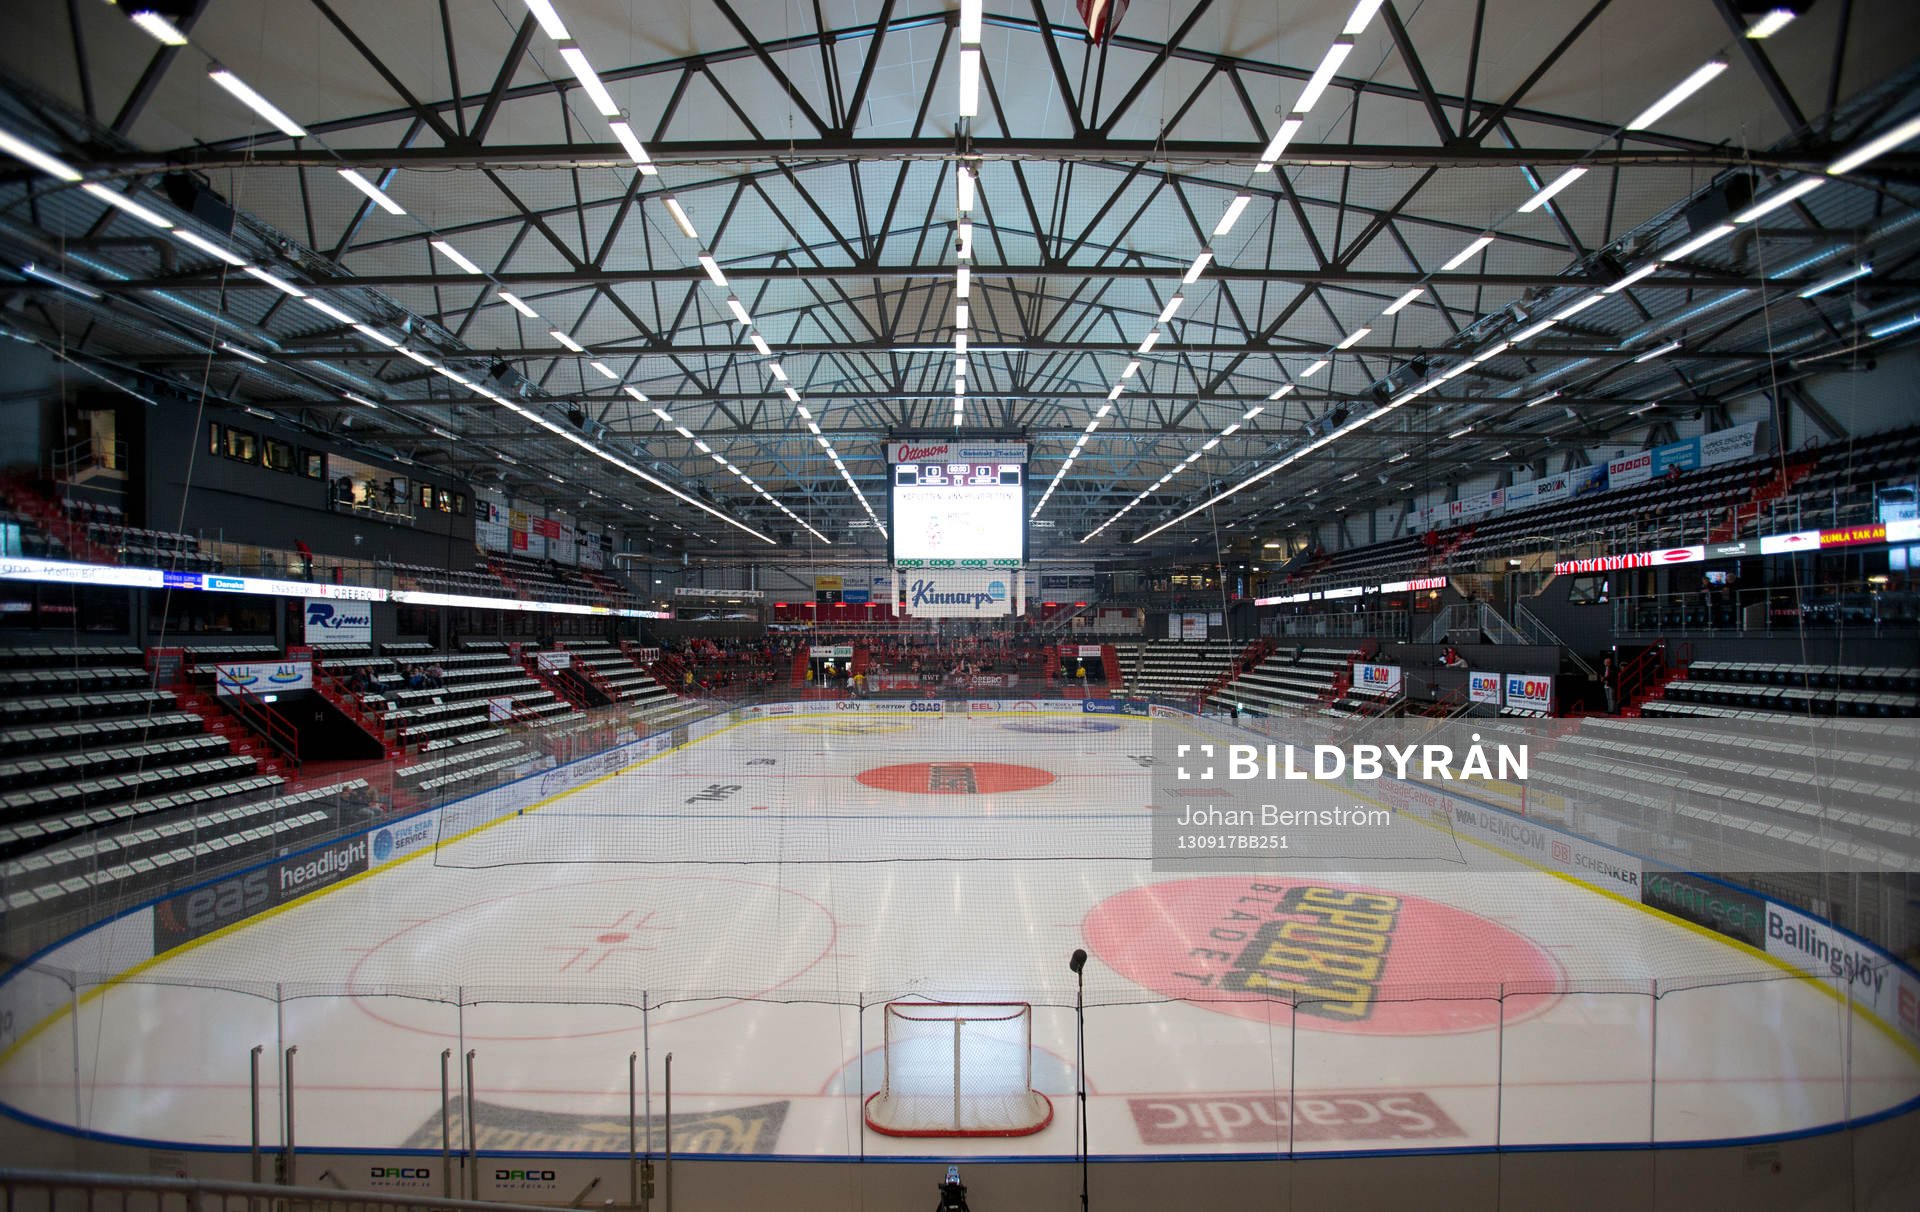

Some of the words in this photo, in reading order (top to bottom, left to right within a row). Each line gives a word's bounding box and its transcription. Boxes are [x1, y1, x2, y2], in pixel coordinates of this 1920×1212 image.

[898, 444, 948, 462] Ottossons
[1820, 532, 1850, 543] KUMLA
[1853, 530, 1870, 540] TAK
[1873, 528, 1885, 538] AB
[897, 559, 924, 567] coop
[929, 559, 955, 567] coop
[961, 559, 987, 567] coop
[993, 559, 1020, 567] coop
[911, 579, 994, 609] Kinnarps
[307, 603, 369, 629] Rejmes
[276, 665, 295, 676] ALI
[1363, 666, 1389, 683] ELON
[1472, 678, 1497, 691] ELON
[1508, 679, 1548, 700] ELON
[909, 700, 942, 712] ÖBAB
[414, 820, 433, 832] STAR
[1480, 813, 1545, 851] DEMCOM
[395, 831, 428, 849] SERVICE
[280, 840, 367, 891] headlight
[1554, 844, 1569, 861] DB
[1574, 852, 1638, 886] SCHENKER
[187, 869, 270, 929] eas
[1173, 882, 1283, 987] BLADET
[1243, 885, 1403, 1019] SPORT
[1768, 911, 1884, 994] Ballingslöv
[1150, 1098, 1436, 1140] Scandic
[371, 1167, 430, 1178] DACO
[495, 1170, 555, 1180] DACO
